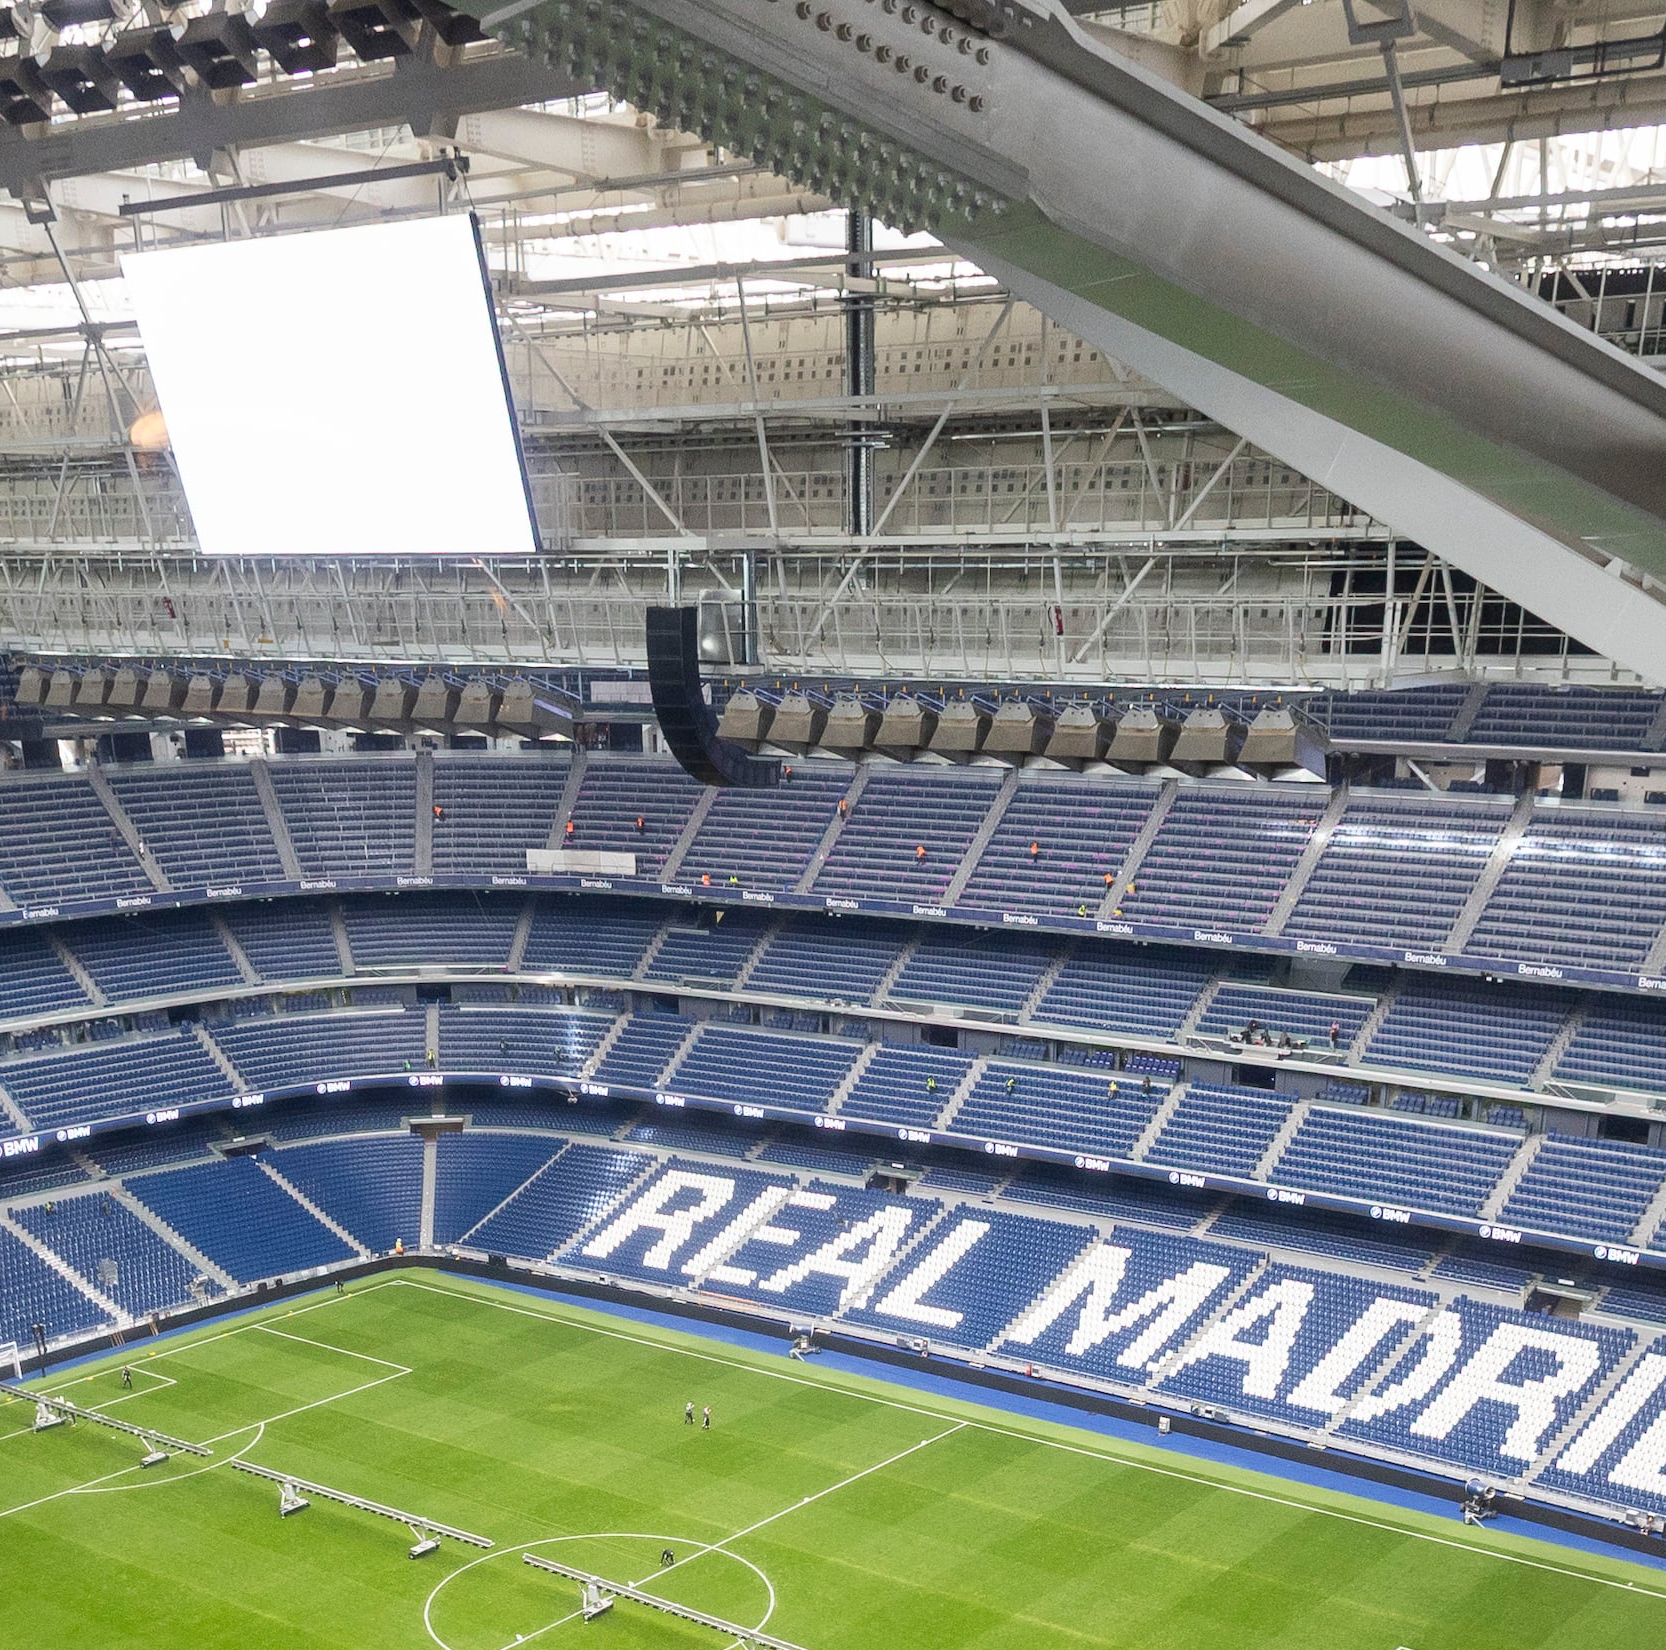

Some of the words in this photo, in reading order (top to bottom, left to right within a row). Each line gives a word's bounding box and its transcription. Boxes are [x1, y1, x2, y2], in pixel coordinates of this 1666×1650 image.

[300, 879, 336, 890] Bernabéu
[397, 876, 433, 885] Bernabéu
[492, 876, 527, 885] Bernabéu
[581, 879, 612, 889] Bernabéu
[206, 886, 242, 897] Bernabéu
[661, 884, 692, 895] Bernabéu
[116, 896, 152, 907] Bernabéu
[742, 891, 774, 902] Bernabéu
[826, 898, 859, 909] Bernabéu
[912, 905, 947, 917] Bernabéu
[1003, 914, 1038, 925] Bernabéu
[1096, 922, 1133, 934] Bernabéu
[1194, 931, 1232, 944] Bernabéu
[1297, 941, 1336, 954] Bernabéu
[1405, 952, 1446, 965] Bernabéu
[1518, 964, 1563, 978] Bernabéu
[326, 1081, 350, 1093] BMW
[419, 1076, 443, 1086] BMW
[509, 1077, 532, 1088] BMW
[588, 1085, 608, 1096] BMW
[241, 1094, 264, 1106] BMW
[665, 1095, 685, 1106] BMW
[155, 1110, 179, 1122] BMW
[743, 1107, 764, 1118] BMW
[824, 1118, 845, 1130] BMW
[67, 1126, 90, 1140] BMW
[908, 1130, 930, 1143] BMW
[3, 1137, 39, 1156] BMW
[995, 1144, 1018, 1157] BMW
[1085, 1158, 1109, 1171] BMW
[1179, 1174, 1206, 1187] BMW
[1278, 1191, 1305, 1205] BMW
[1382, 1209, 1411, 1224] BMW
[1491, 1228, 1521, 1243] BMW
[582, 1169, 991, 1329] REAL
[1607, 1249, 1639, 1265] BMW
